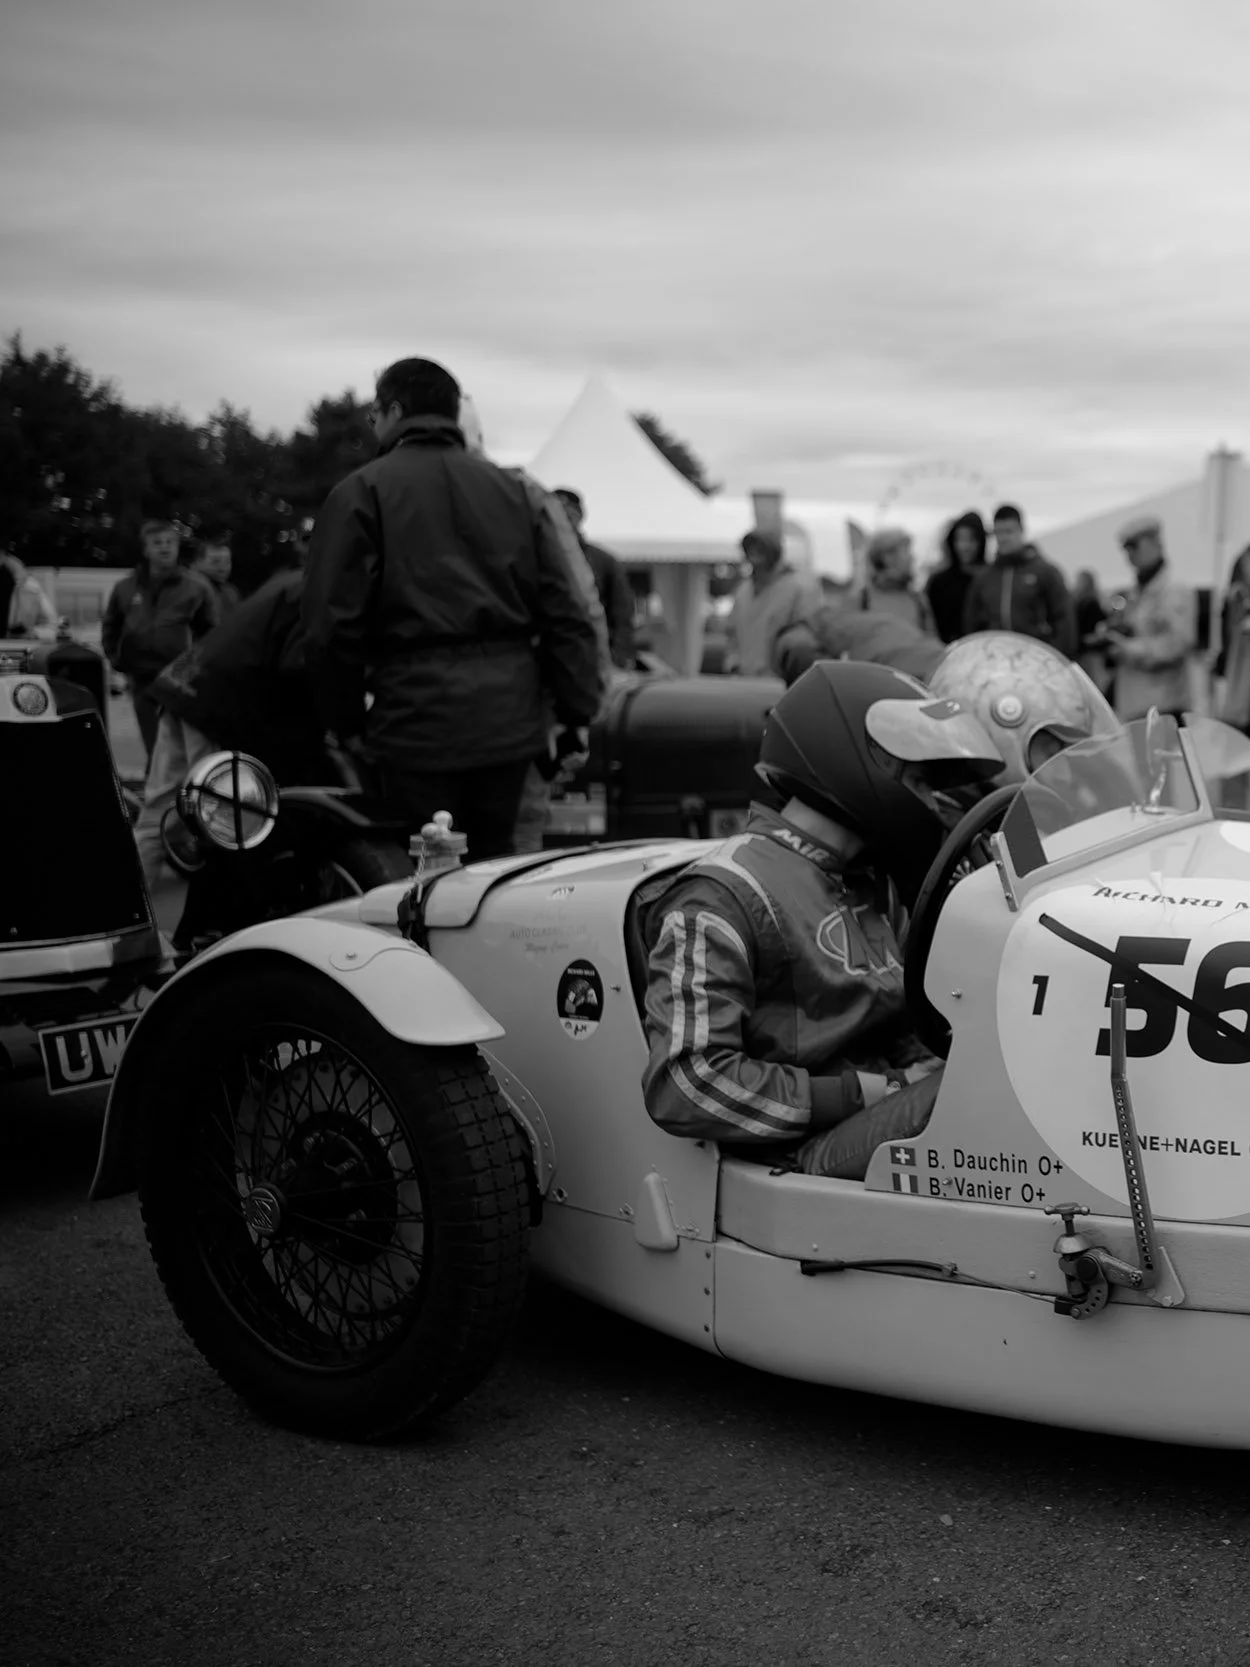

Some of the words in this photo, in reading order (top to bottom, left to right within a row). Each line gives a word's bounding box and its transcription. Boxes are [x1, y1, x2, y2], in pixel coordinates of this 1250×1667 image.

[1032, 975, 1049, 1016] 1
[1082, 1131, 1241, 1156] KUENE+NAGEL
[928, 1148, 945, 1169] B.
[954, 1149, 1028, 1175] Dauchin
[1038, 1155, 1064, 1176] O+
[929, 1177, 947, 1197] B.
[954, 1177, 1012, 1201] Vanier
[1021, 1183, 1046, 1203] O+
